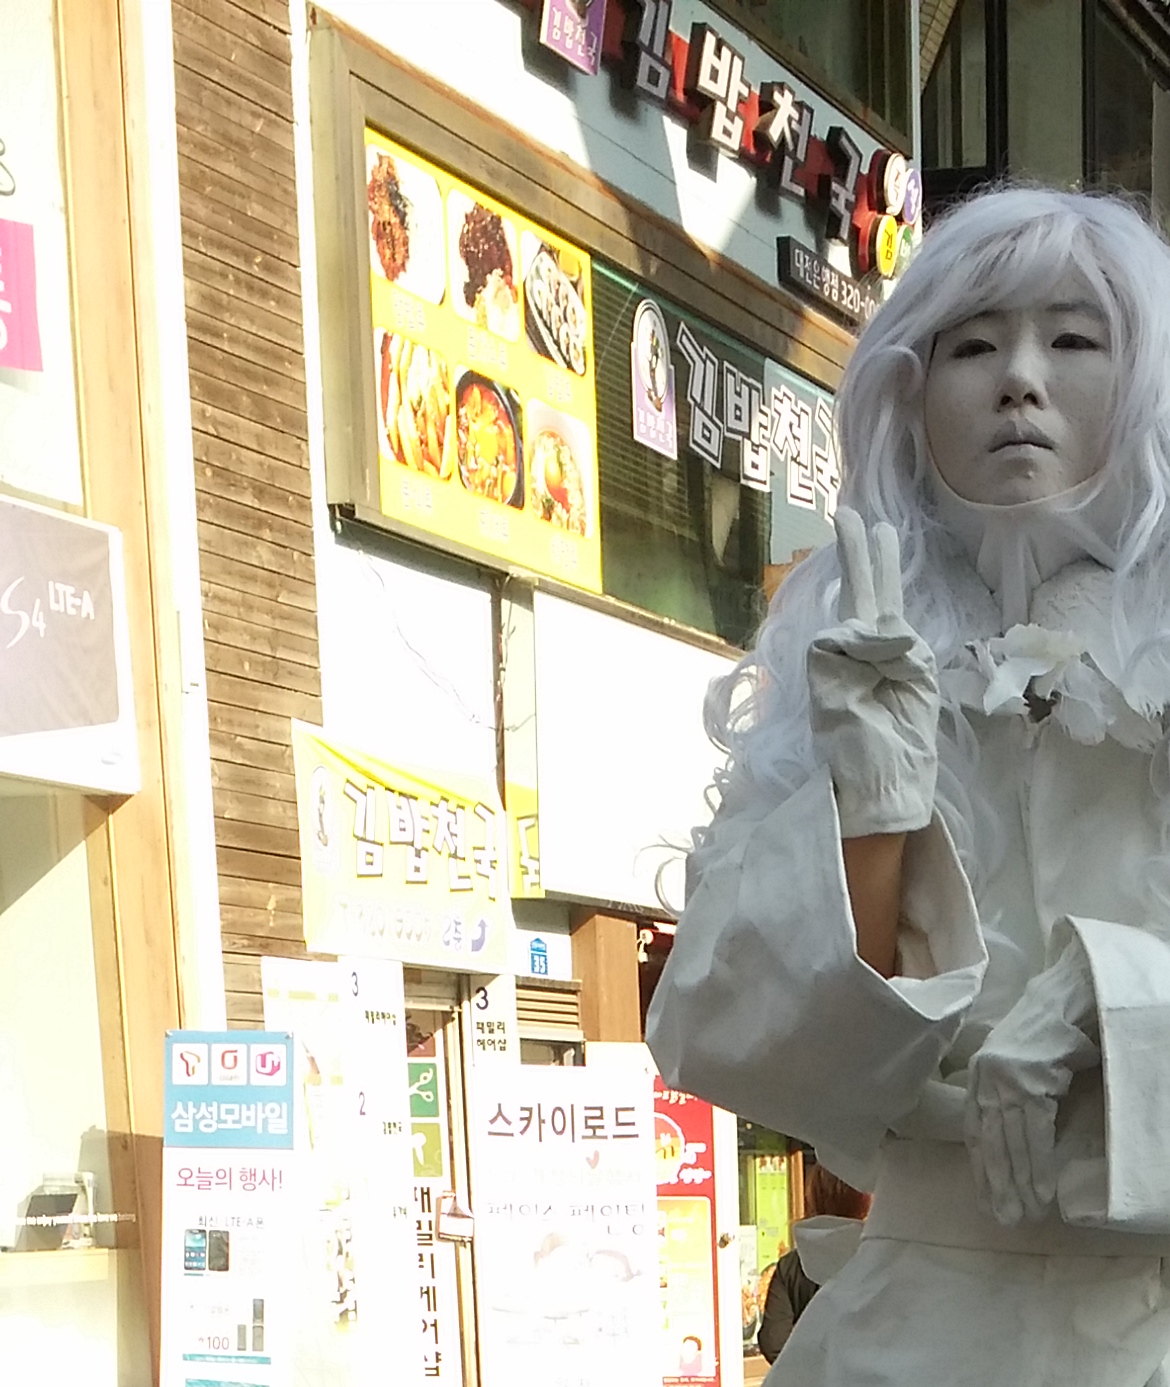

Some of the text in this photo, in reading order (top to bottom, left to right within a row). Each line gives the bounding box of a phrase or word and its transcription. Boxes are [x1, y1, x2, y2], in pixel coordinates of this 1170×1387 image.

[636, 0, 864, 243] 김밥천국
[48, 580, 95, 620] LTE-A
[343, 777, 498, 902] 김밥천국
[534, 954, 546, 974] 35
[351, 971, 359, 997] 3
[475, 986, 489, 1010] 3
[171, 1100, 289, 1134] 삼성모바일
[359, 1091, 366, 1116] 2
[487, 1102, 640, 1143] 스카이로드
[176, 1166, 283, 1192] 오늘의 행사!
